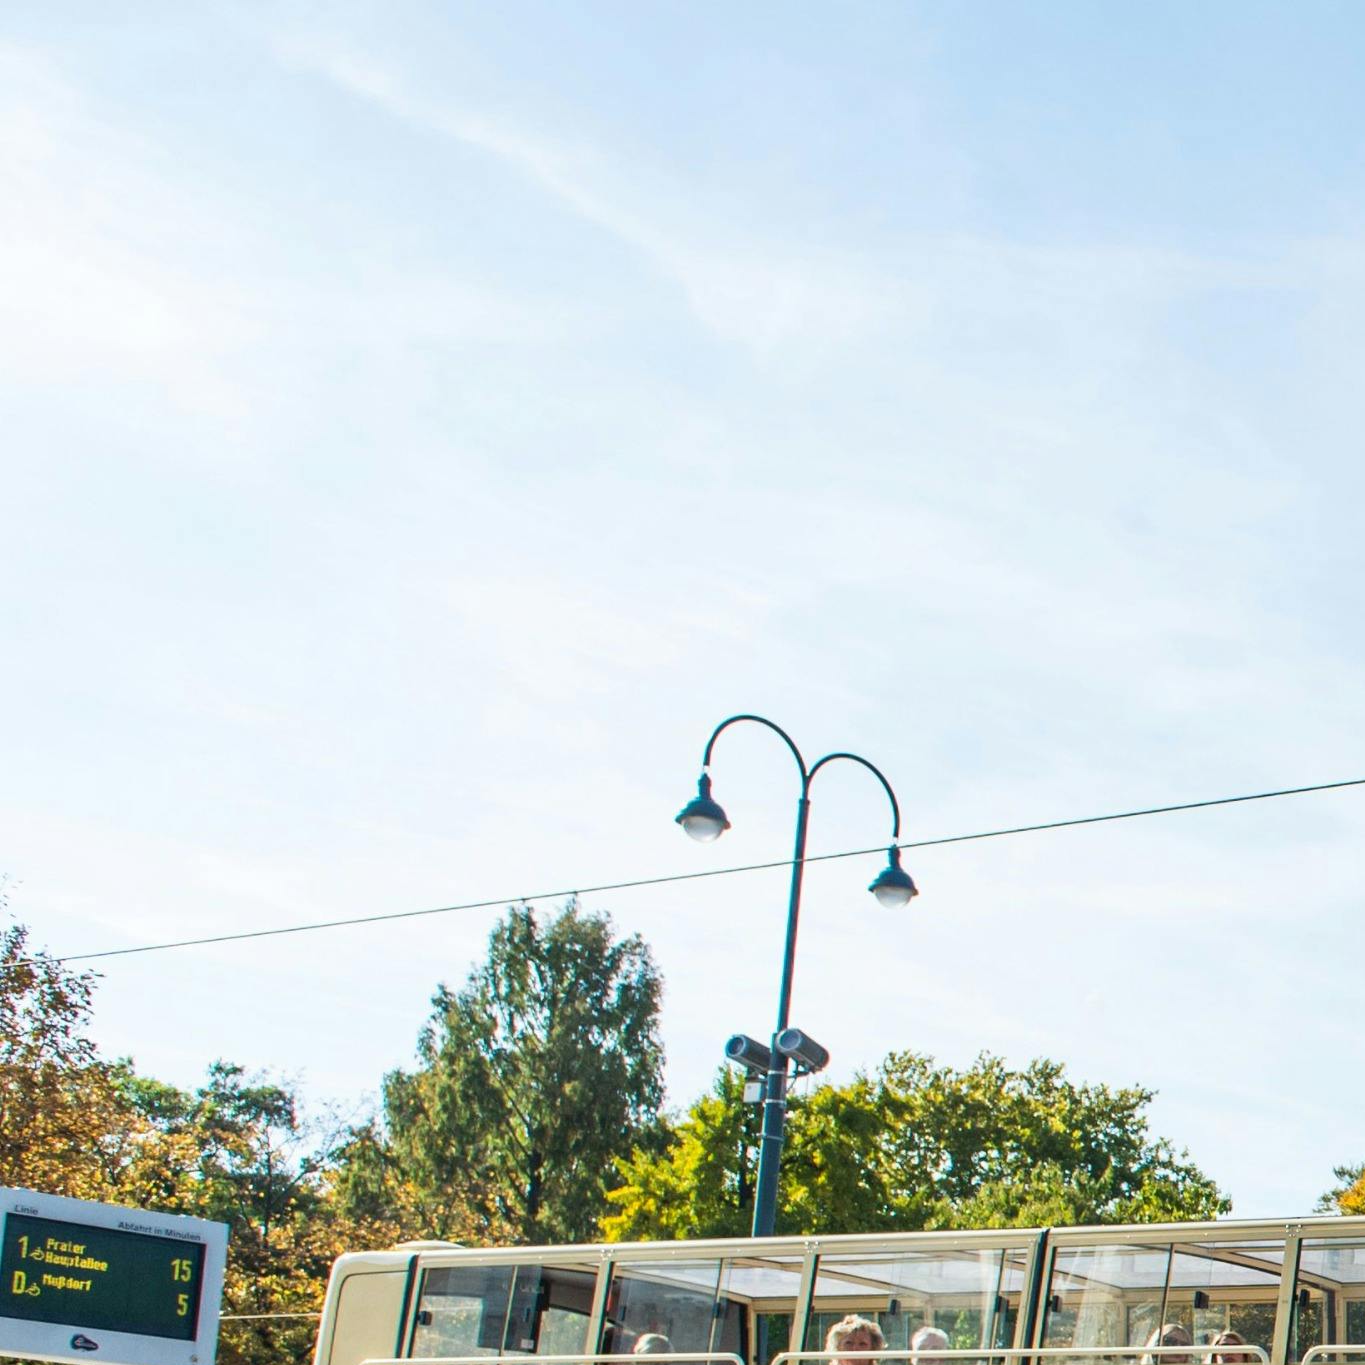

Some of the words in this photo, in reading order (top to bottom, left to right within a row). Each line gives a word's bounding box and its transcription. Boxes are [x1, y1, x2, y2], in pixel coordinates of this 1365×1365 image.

[14, 1204, 39, 1215] Linie
[117, 1221, 152, 1234] Abfahrt
[164, 1229, 201, 1241] Minuten
[17, 1235, 29, 1259] 1
[46, 1238, 87, 1255] Prater
[44, 1251, 108, 1272] Hauptallee
[170, 1258, 193, 1283] 15
[12, 1270, 26, 1294] D
[176, 1293, 189, 1316] 5
